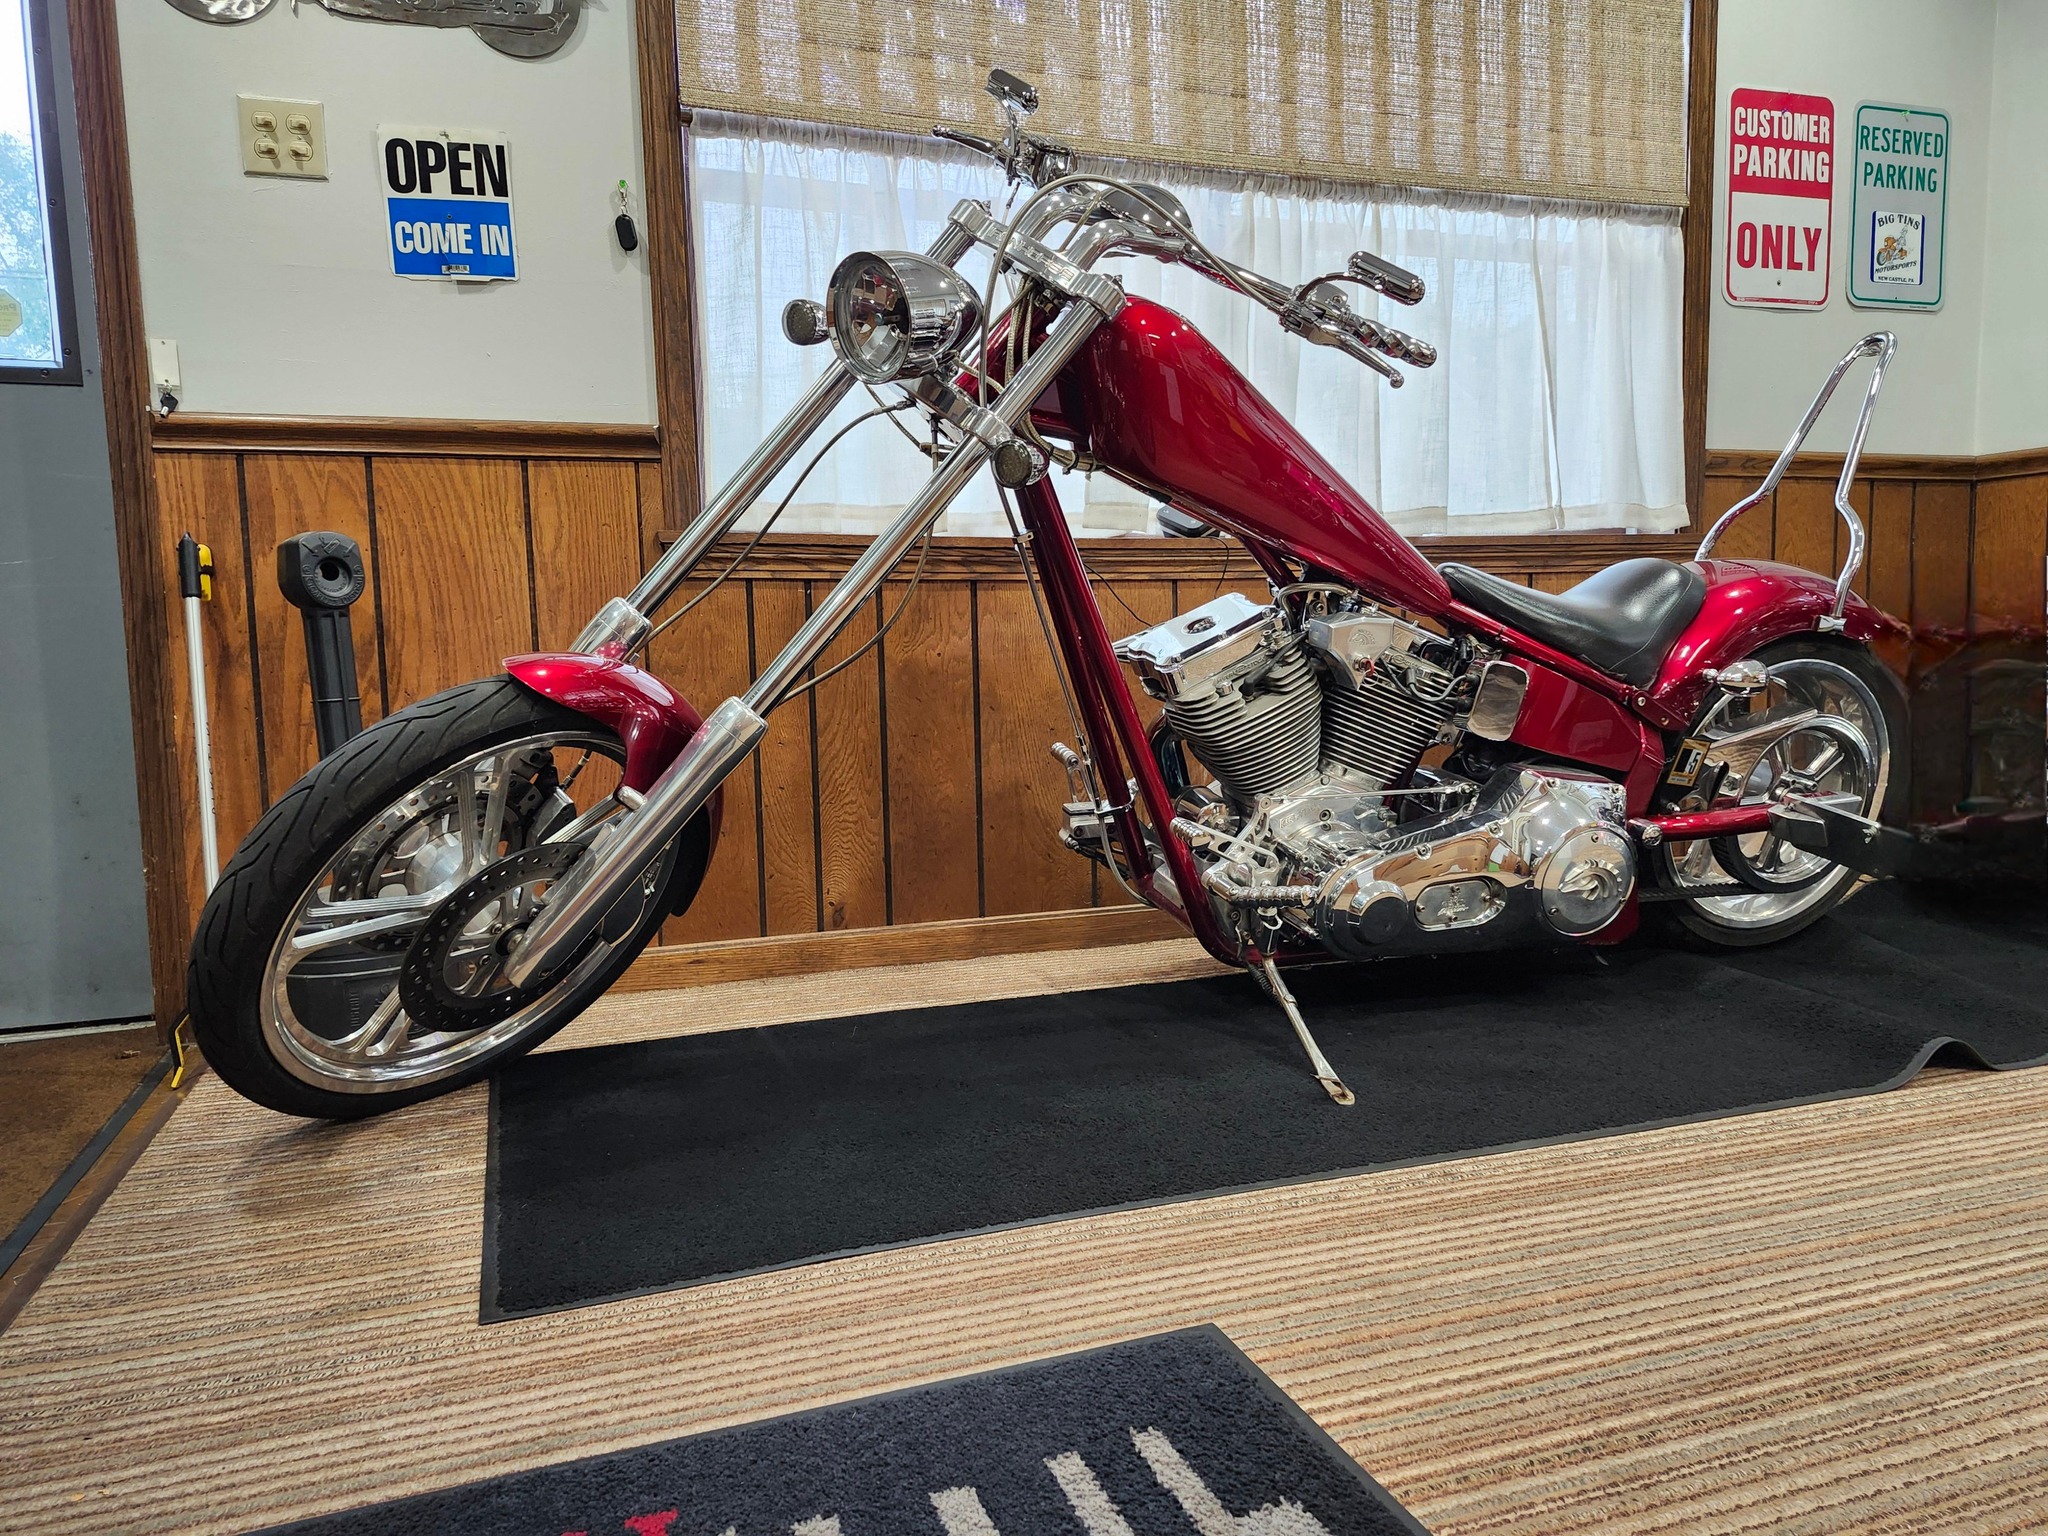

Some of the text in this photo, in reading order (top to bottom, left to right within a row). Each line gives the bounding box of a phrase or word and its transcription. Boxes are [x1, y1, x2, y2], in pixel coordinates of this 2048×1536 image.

[1734, 107, 1830, 144] CUSTOMER
[1860, 125, 1944, 158] RESERVED
[385, 138, 509, 198] OPEN
[1733, 143, 1830, 183] PARKING
[1863, 161, 1937, 193] PARKING
[394, 220, 510, 257] COME IN
[1877, 213, 1921, 230] BIG TINS
[1736, 221, 1823, 272] ONLY
[1874, 260, 1918, 274] MOTORSPORTS
